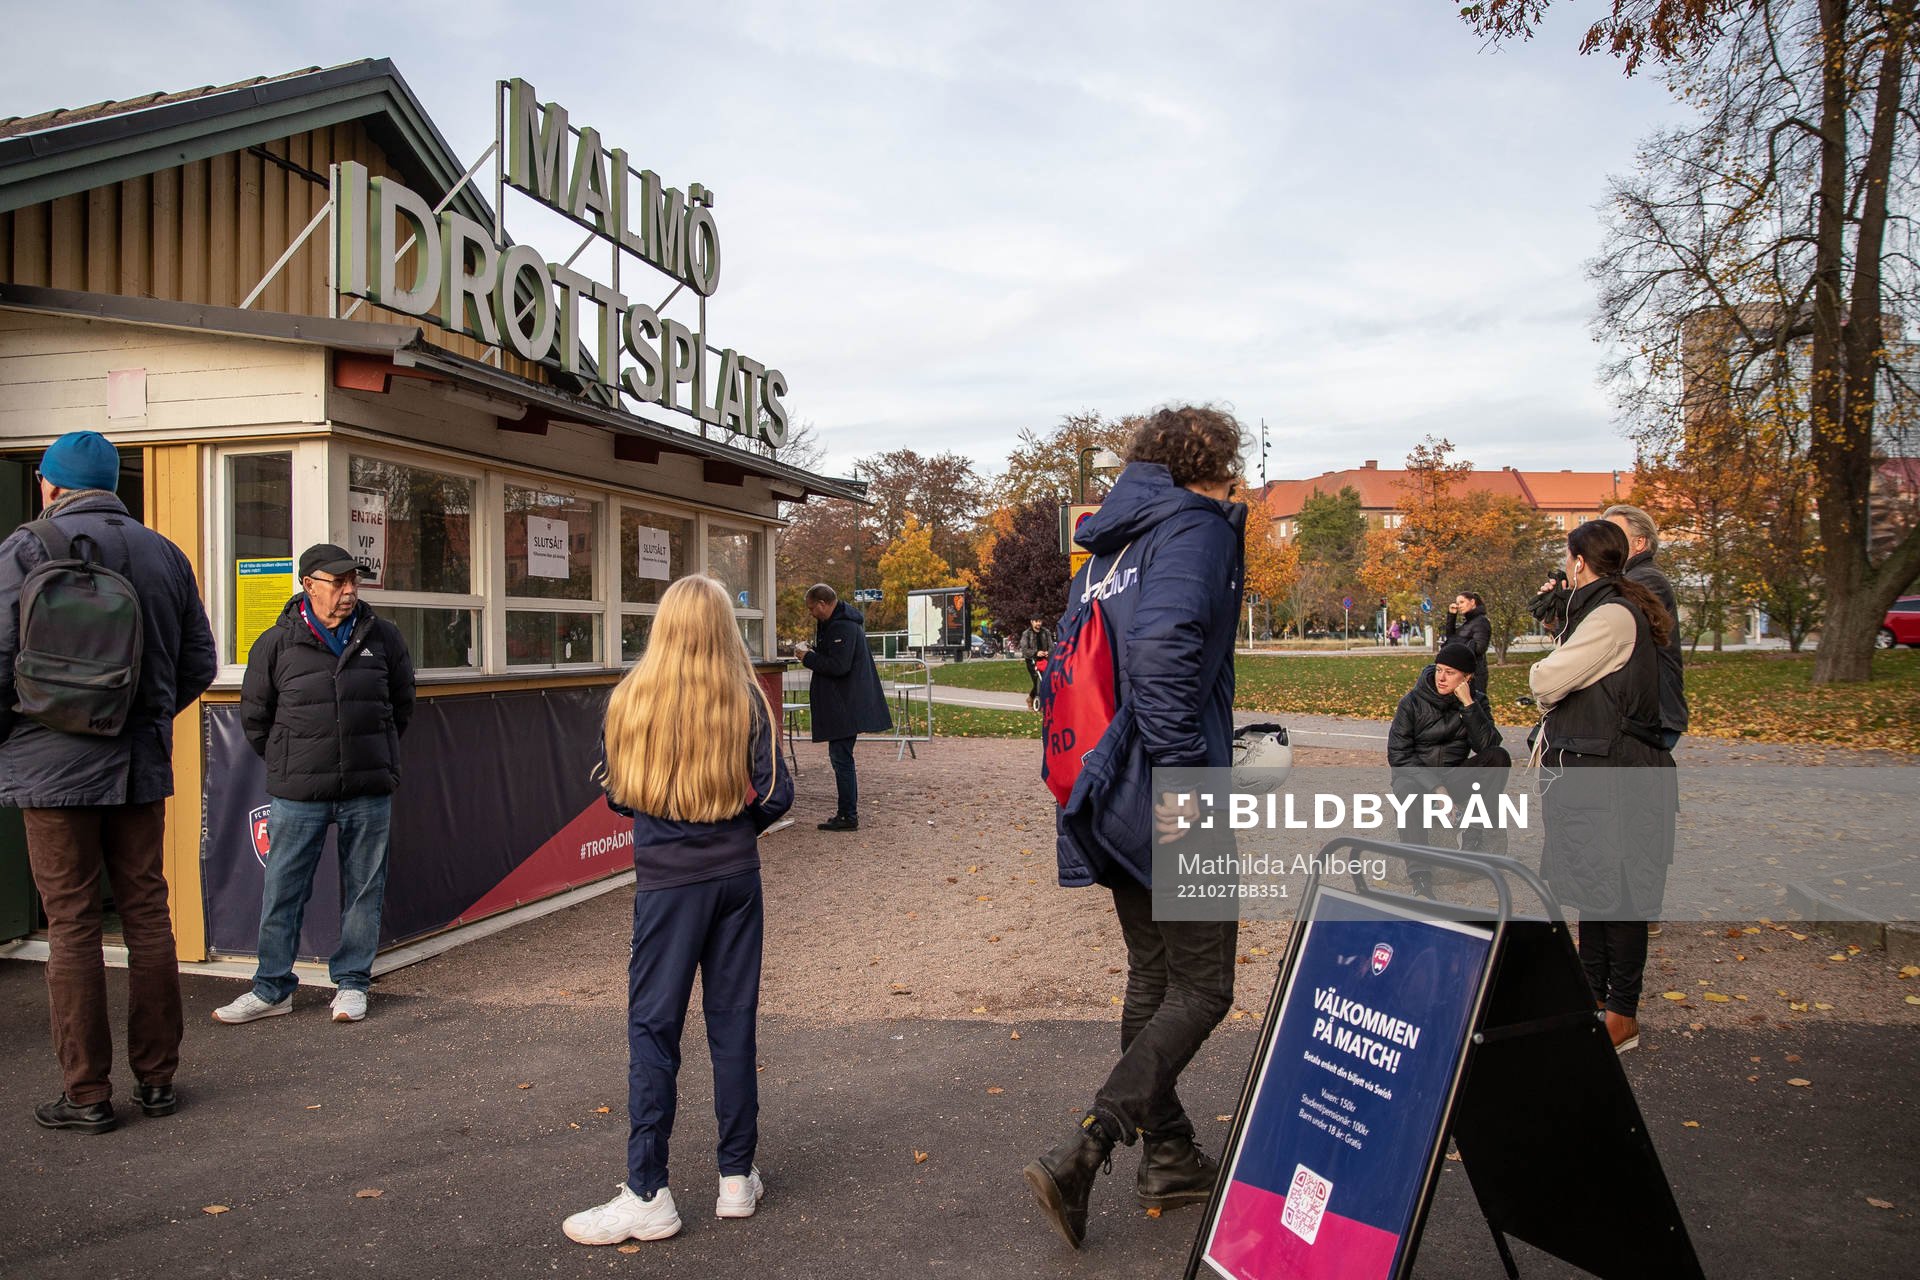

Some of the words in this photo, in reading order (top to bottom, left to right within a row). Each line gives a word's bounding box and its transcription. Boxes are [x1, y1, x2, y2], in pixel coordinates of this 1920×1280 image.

[510, 77, 720, 297] MALMÖ
[341, 160, 789, 449] IDROTTSPLATS
[351, 509, 383, 525] ENTRÉ
[358, 535, 375, 549] VIP
[533, 535, 564, 550] SLUTSÅLT
[1314, 986, 1421, 1050] VÄLKOMMEN
[1312, 1016, 1333, 1045] PÅ
[1334, 1026, 1401, 1074] MATCH!
[1303, 1050, 1321, 1066] Betala
[1321, 1060, 1337, 1074] enkelt
[1337, 1067, 1347, 1079] din
[1347, 1071, 1365, 1086] biljett
[1365, 1081, 1374, 1092] via
[1373, 1083, 1392, 1100] Swish
[1340, 1098, 1357, 1112] 150kr
[1299, 1108, 1312, 1121] Barn
[1312, 1118, 1328, 1130] under
[1328, 1124, 1336, 1135] 18
[1344, 1133, 1362, 1149] Gratis
[1352, 1121, 1370, 1136] 100kr
